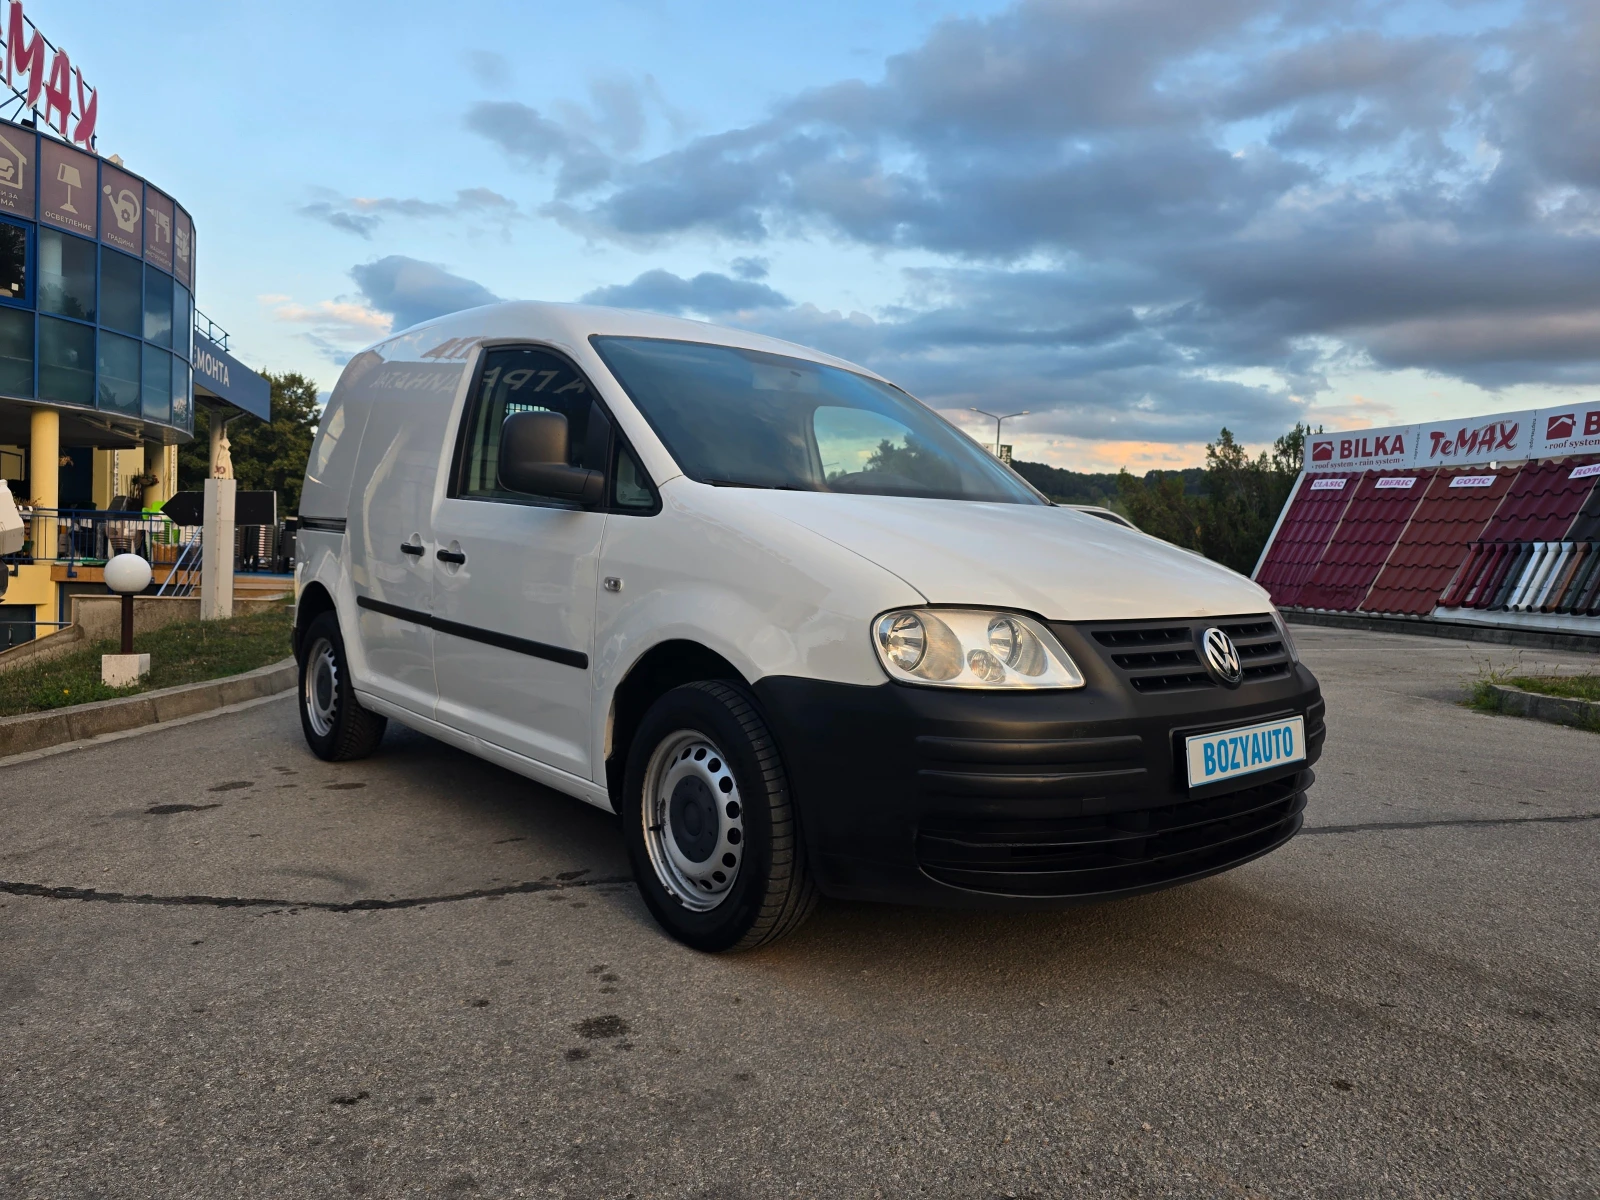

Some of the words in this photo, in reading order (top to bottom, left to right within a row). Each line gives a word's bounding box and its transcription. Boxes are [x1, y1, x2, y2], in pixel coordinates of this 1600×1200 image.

[0, 0, 98, 154] MAX
[44, 210, 93, 232] ОСВЕТЛЕНИЕ
[107, 232, 135, 249] ГРАДИНА
[1339, 434, 1405, 460] BILKA
[1429, 422, 1520, 459] TeMAX
[1548, 439, 1568, 450] roof
[1315, 461, 1330, 470] roof
[1330, 461, 1354, 470] system
[1374, 457, 1400, 466] system
[1313, 480, 1344, 488] CLASIC
[1379, 479, 1412, 487] IBERIC
[1455, 477, 1490, 485] GOTIC
[1202, 726, 1293, 777] BOZYAUTO
